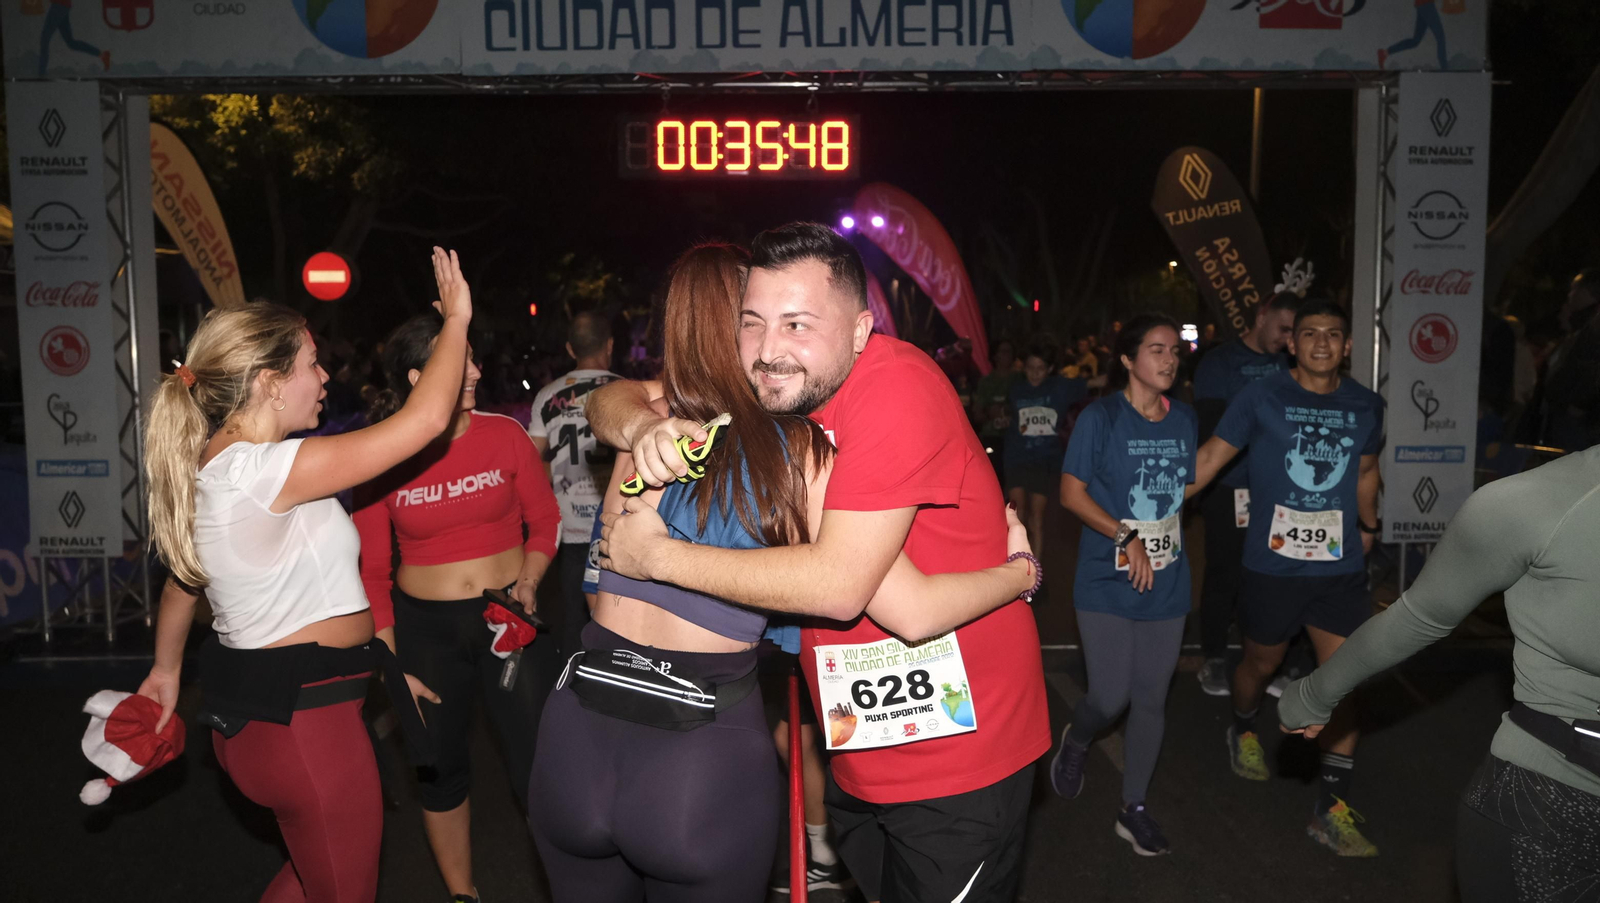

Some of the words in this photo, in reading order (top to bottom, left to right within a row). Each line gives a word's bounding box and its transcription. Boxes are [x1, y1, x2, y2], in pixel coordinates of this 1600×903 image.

[193, 3, 246, 16] CIUDAD
[484, 0, 676, 51] CIUDAD
[696, 0, 761, 49] DE
[656, 120, 850, 171] 00:35:48
[1408, 146, 1475, 156] RENAULT
[20, 156, 88, 167] RENAULT
[1407, 211, 1470, 220] NISSAN
[24, 222, 89, 231] NISSAN
[396, 483, 443, 507] NEW
[446, 469, 505, 498] YORK
[1393, 522, 1446, 531] RENAUL
[39, 536, 105, 546] RENAULT
[1286, 527, 1327, 543] 439
[842, 649, 858, 661] XIV
[861, 646, 885, 659] SAN
[845, 658, 885, 673] CIUDAD
[886, 654, 902, 668] DE
[851, 669, 934, 710] 628
[865, 711, 888, 723] PUXA
[890, 703, 934, 720] SPORTING
